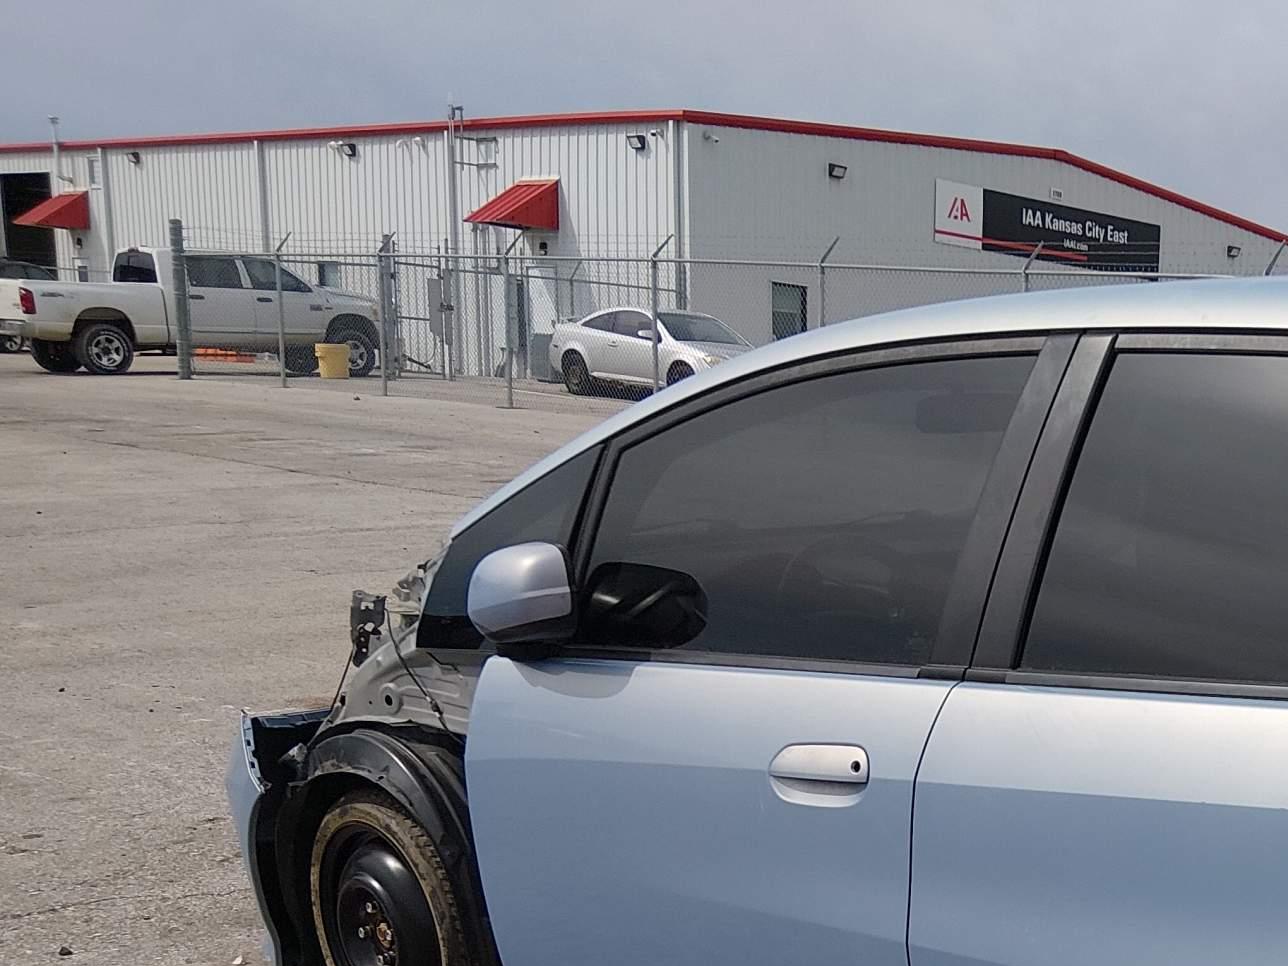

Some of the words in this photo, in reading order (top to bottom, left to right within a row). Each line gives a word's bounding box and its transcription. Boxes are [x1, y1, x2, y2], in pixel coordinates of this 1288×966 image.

[1022, 207, 1043, 228] IAA
[1045, 211, 1083, 236] Kansas
[1085, 220, 1106, 243] City
[1107, 224, 1129, 244] East
